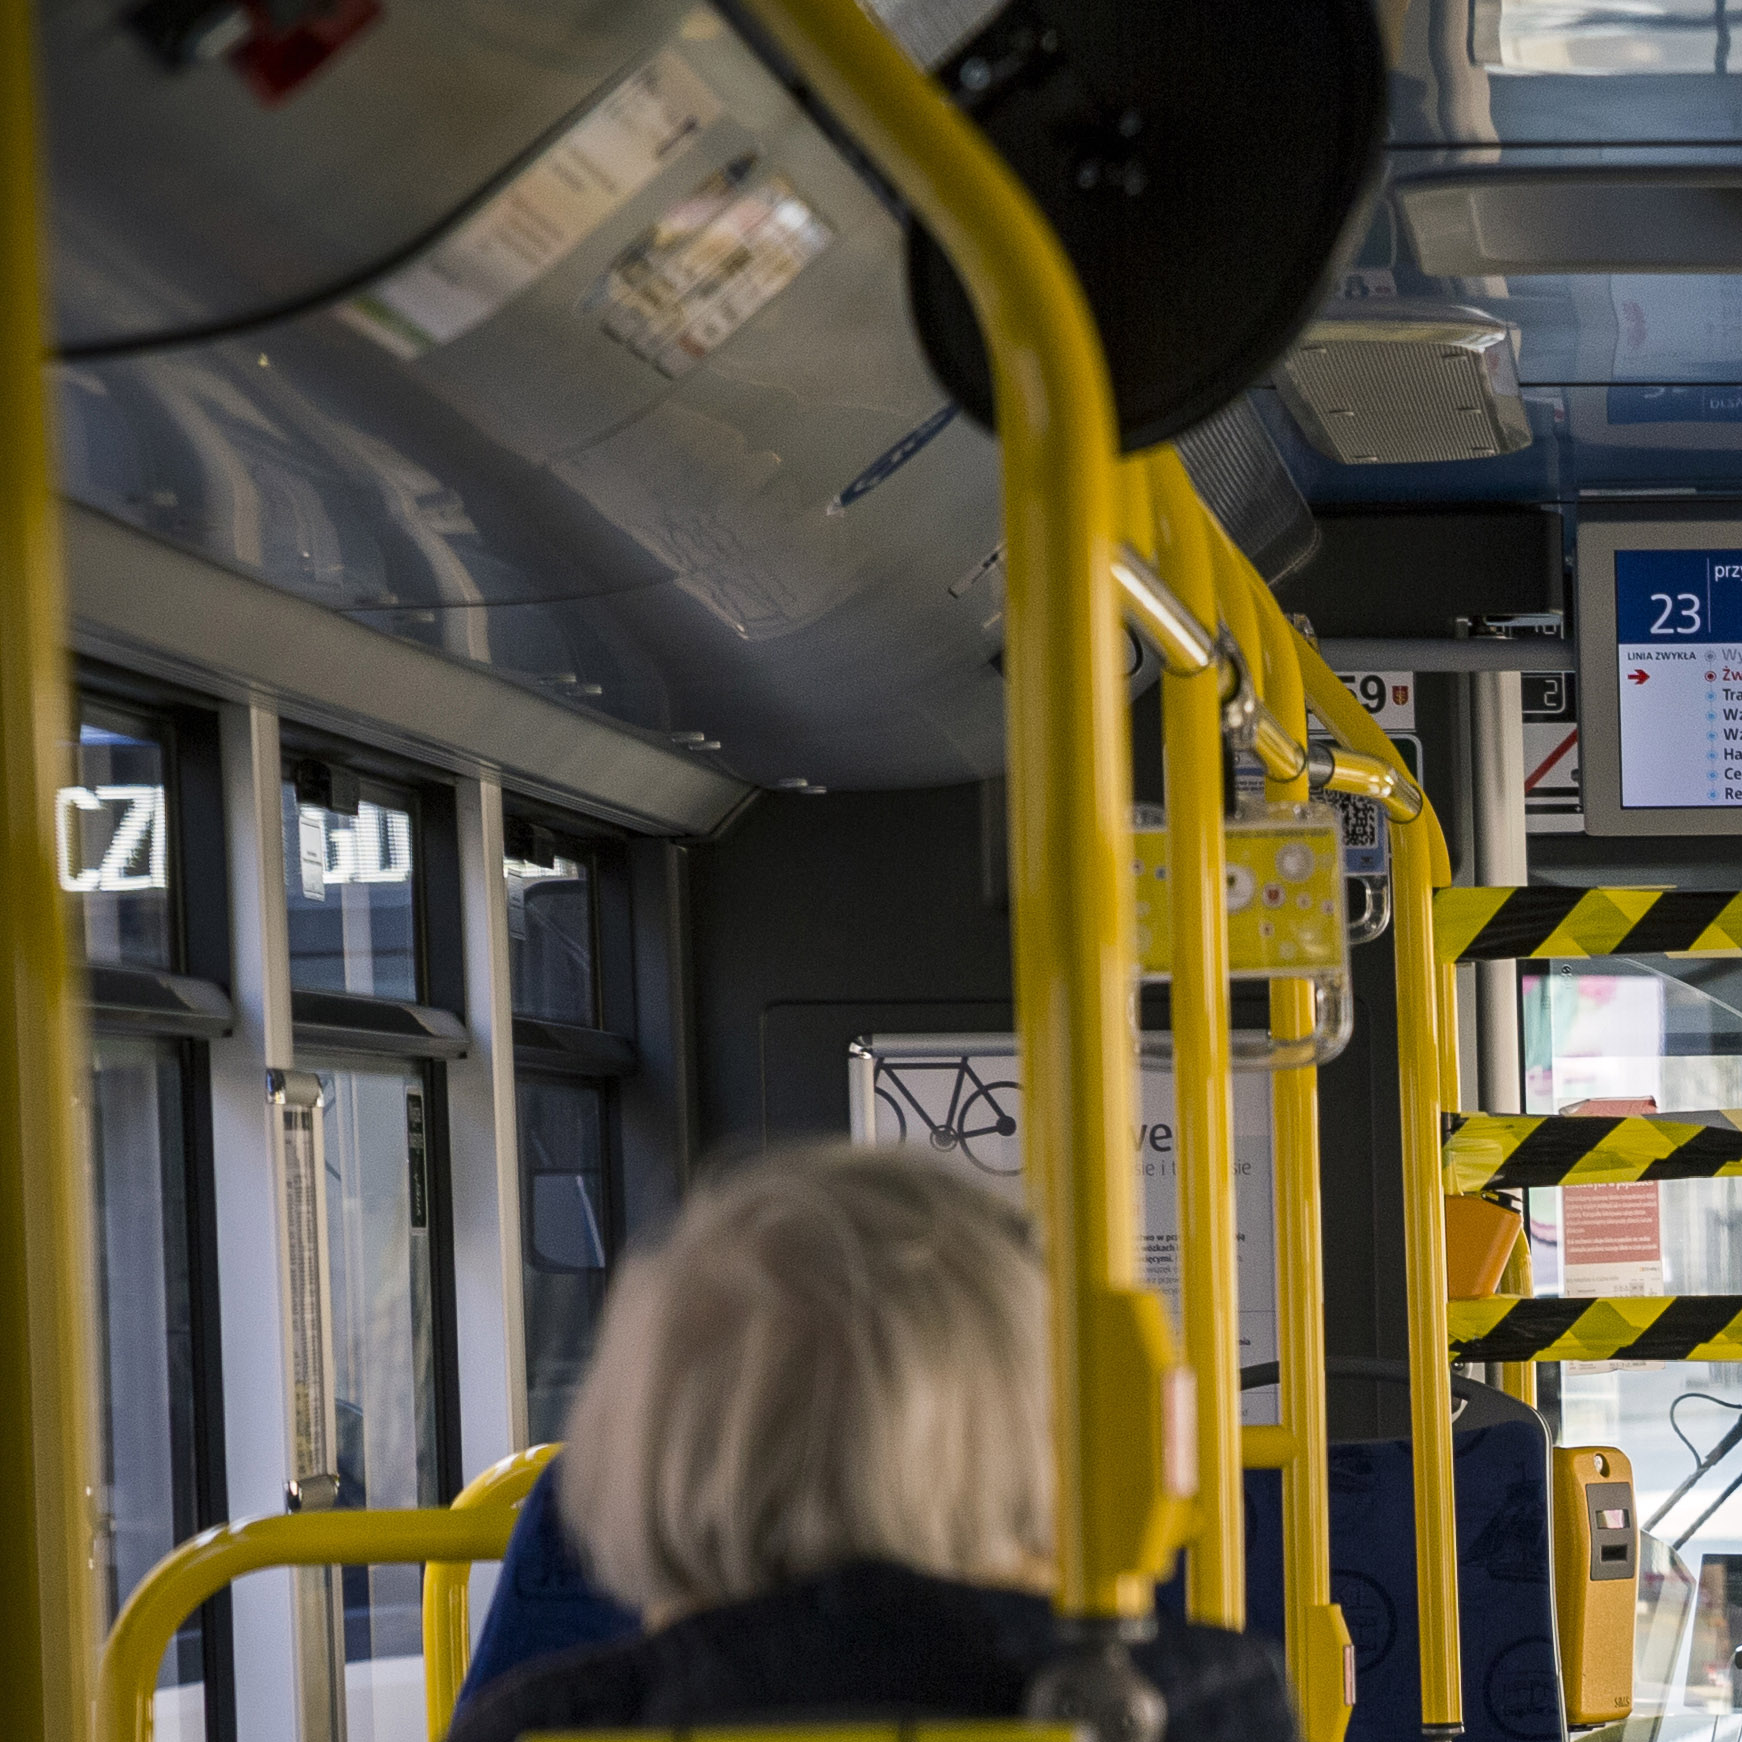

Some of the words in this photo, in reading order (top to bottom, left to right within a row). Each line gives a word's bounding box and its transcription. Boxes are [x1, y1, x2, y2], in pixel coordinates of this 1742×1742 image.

[1650, 593, 1701, 635] 23
[1627, 651, 1653, 661] LINIA
[1655, 651, 1697, 661] ZWYKŁA
